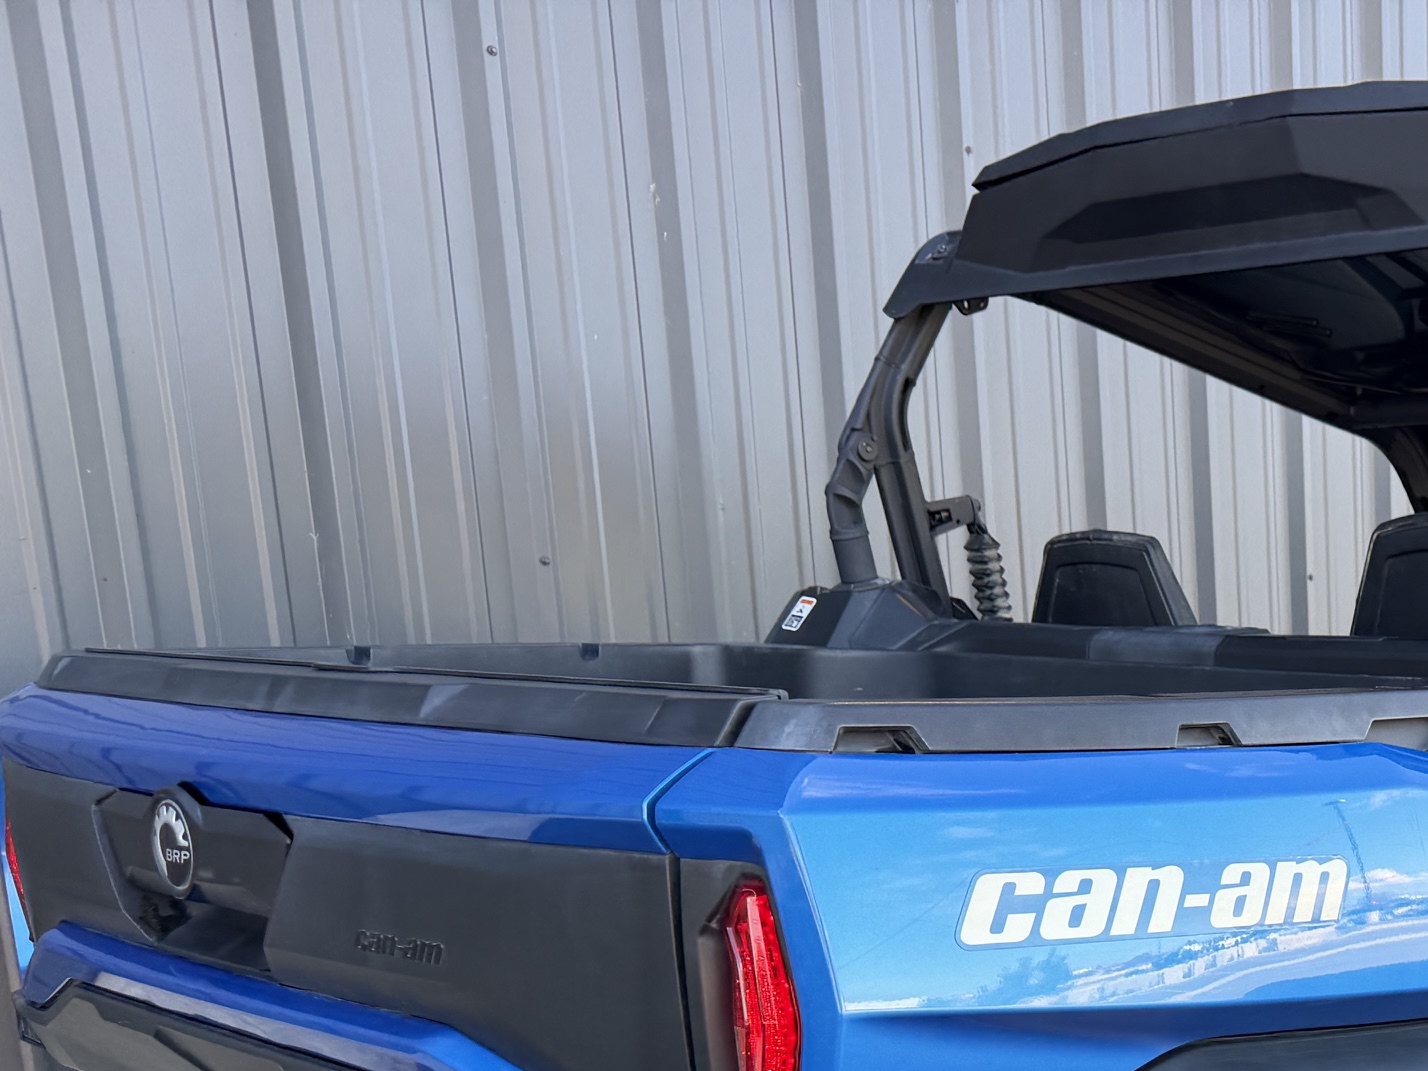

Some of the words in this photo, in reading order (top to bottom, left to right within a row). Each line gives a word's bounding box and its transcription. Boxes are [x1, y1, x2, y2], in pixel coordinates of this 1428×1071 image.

[165, 848, 190, 864] BRP
[960, 858, 1347, 946] can-am
[355, 929, 445, 965] can-am
